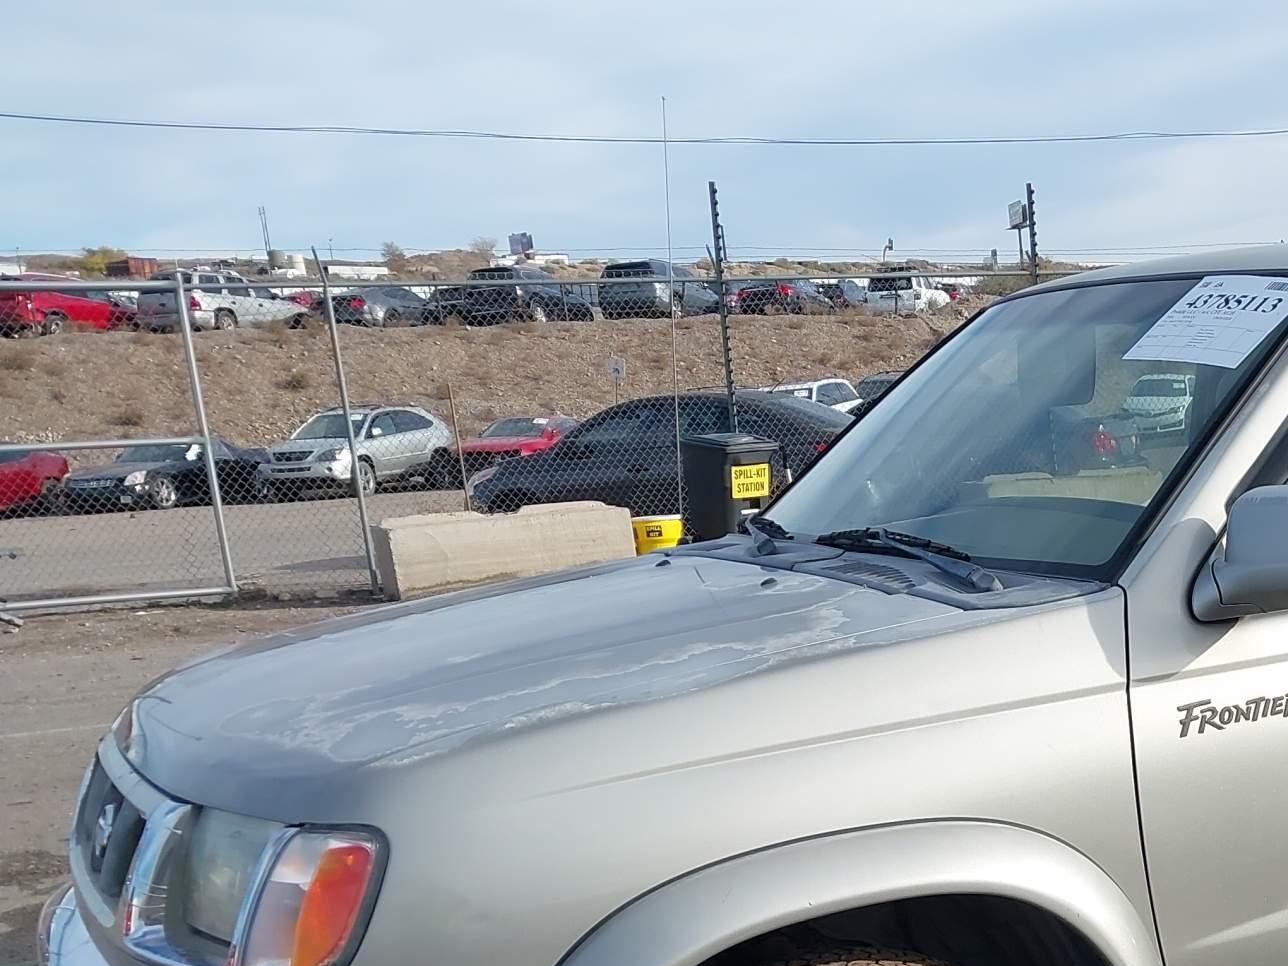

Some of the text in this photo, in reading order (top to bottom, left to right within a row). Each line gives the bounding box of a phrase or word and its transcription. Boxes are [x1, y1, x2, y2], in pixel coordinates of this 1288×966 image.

[1186, 294, 1283, 313] 43785113
[734, 467, 766, 480] SPILL-KIT
[737, 481, 765, 493] STATION
